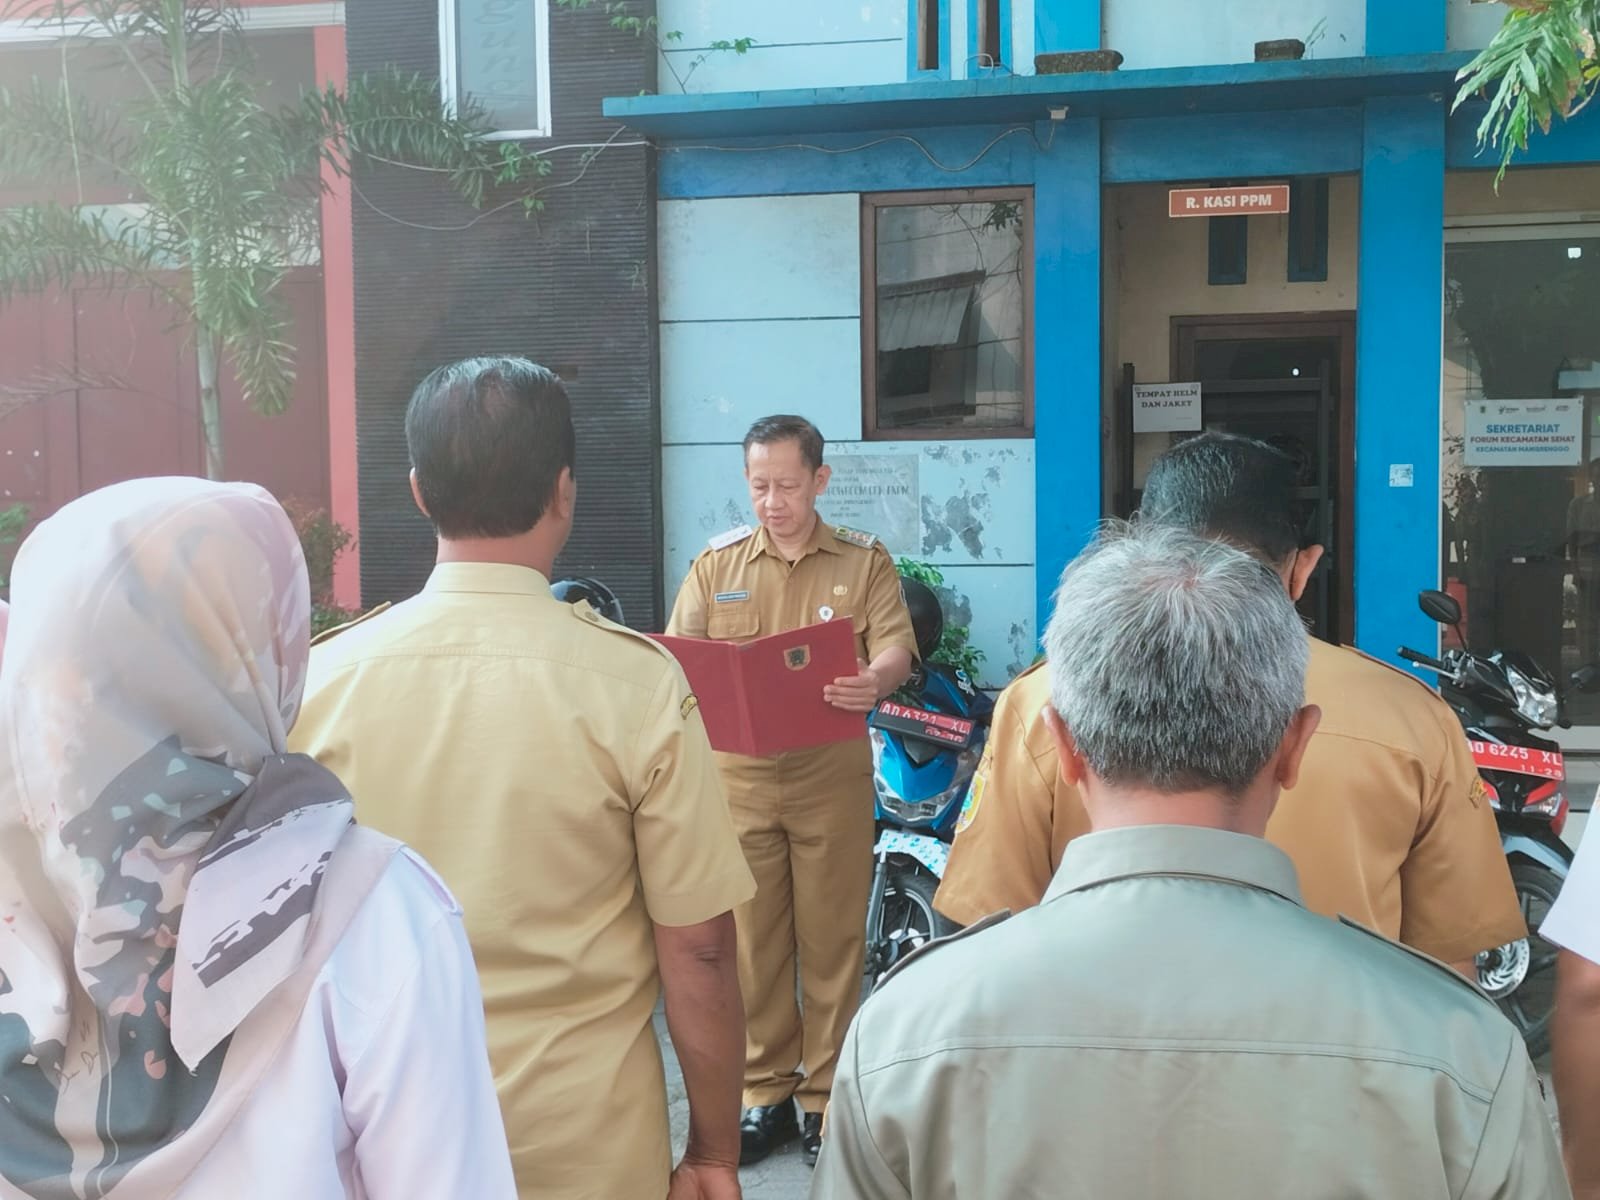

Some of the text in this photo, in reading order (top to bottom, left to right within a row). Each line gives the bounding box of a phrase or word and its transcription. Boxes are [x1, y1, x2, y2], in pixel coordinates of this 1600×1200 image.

[1186, 193, 1272, 208] R. KASI PPM
[1486, 424, 1560, 433] SEKRETARIAT
[950, 719, 969, 734] XL
[1489, 744, 1529, 759] 6245
[1542, 750, 1562, 766] XL
